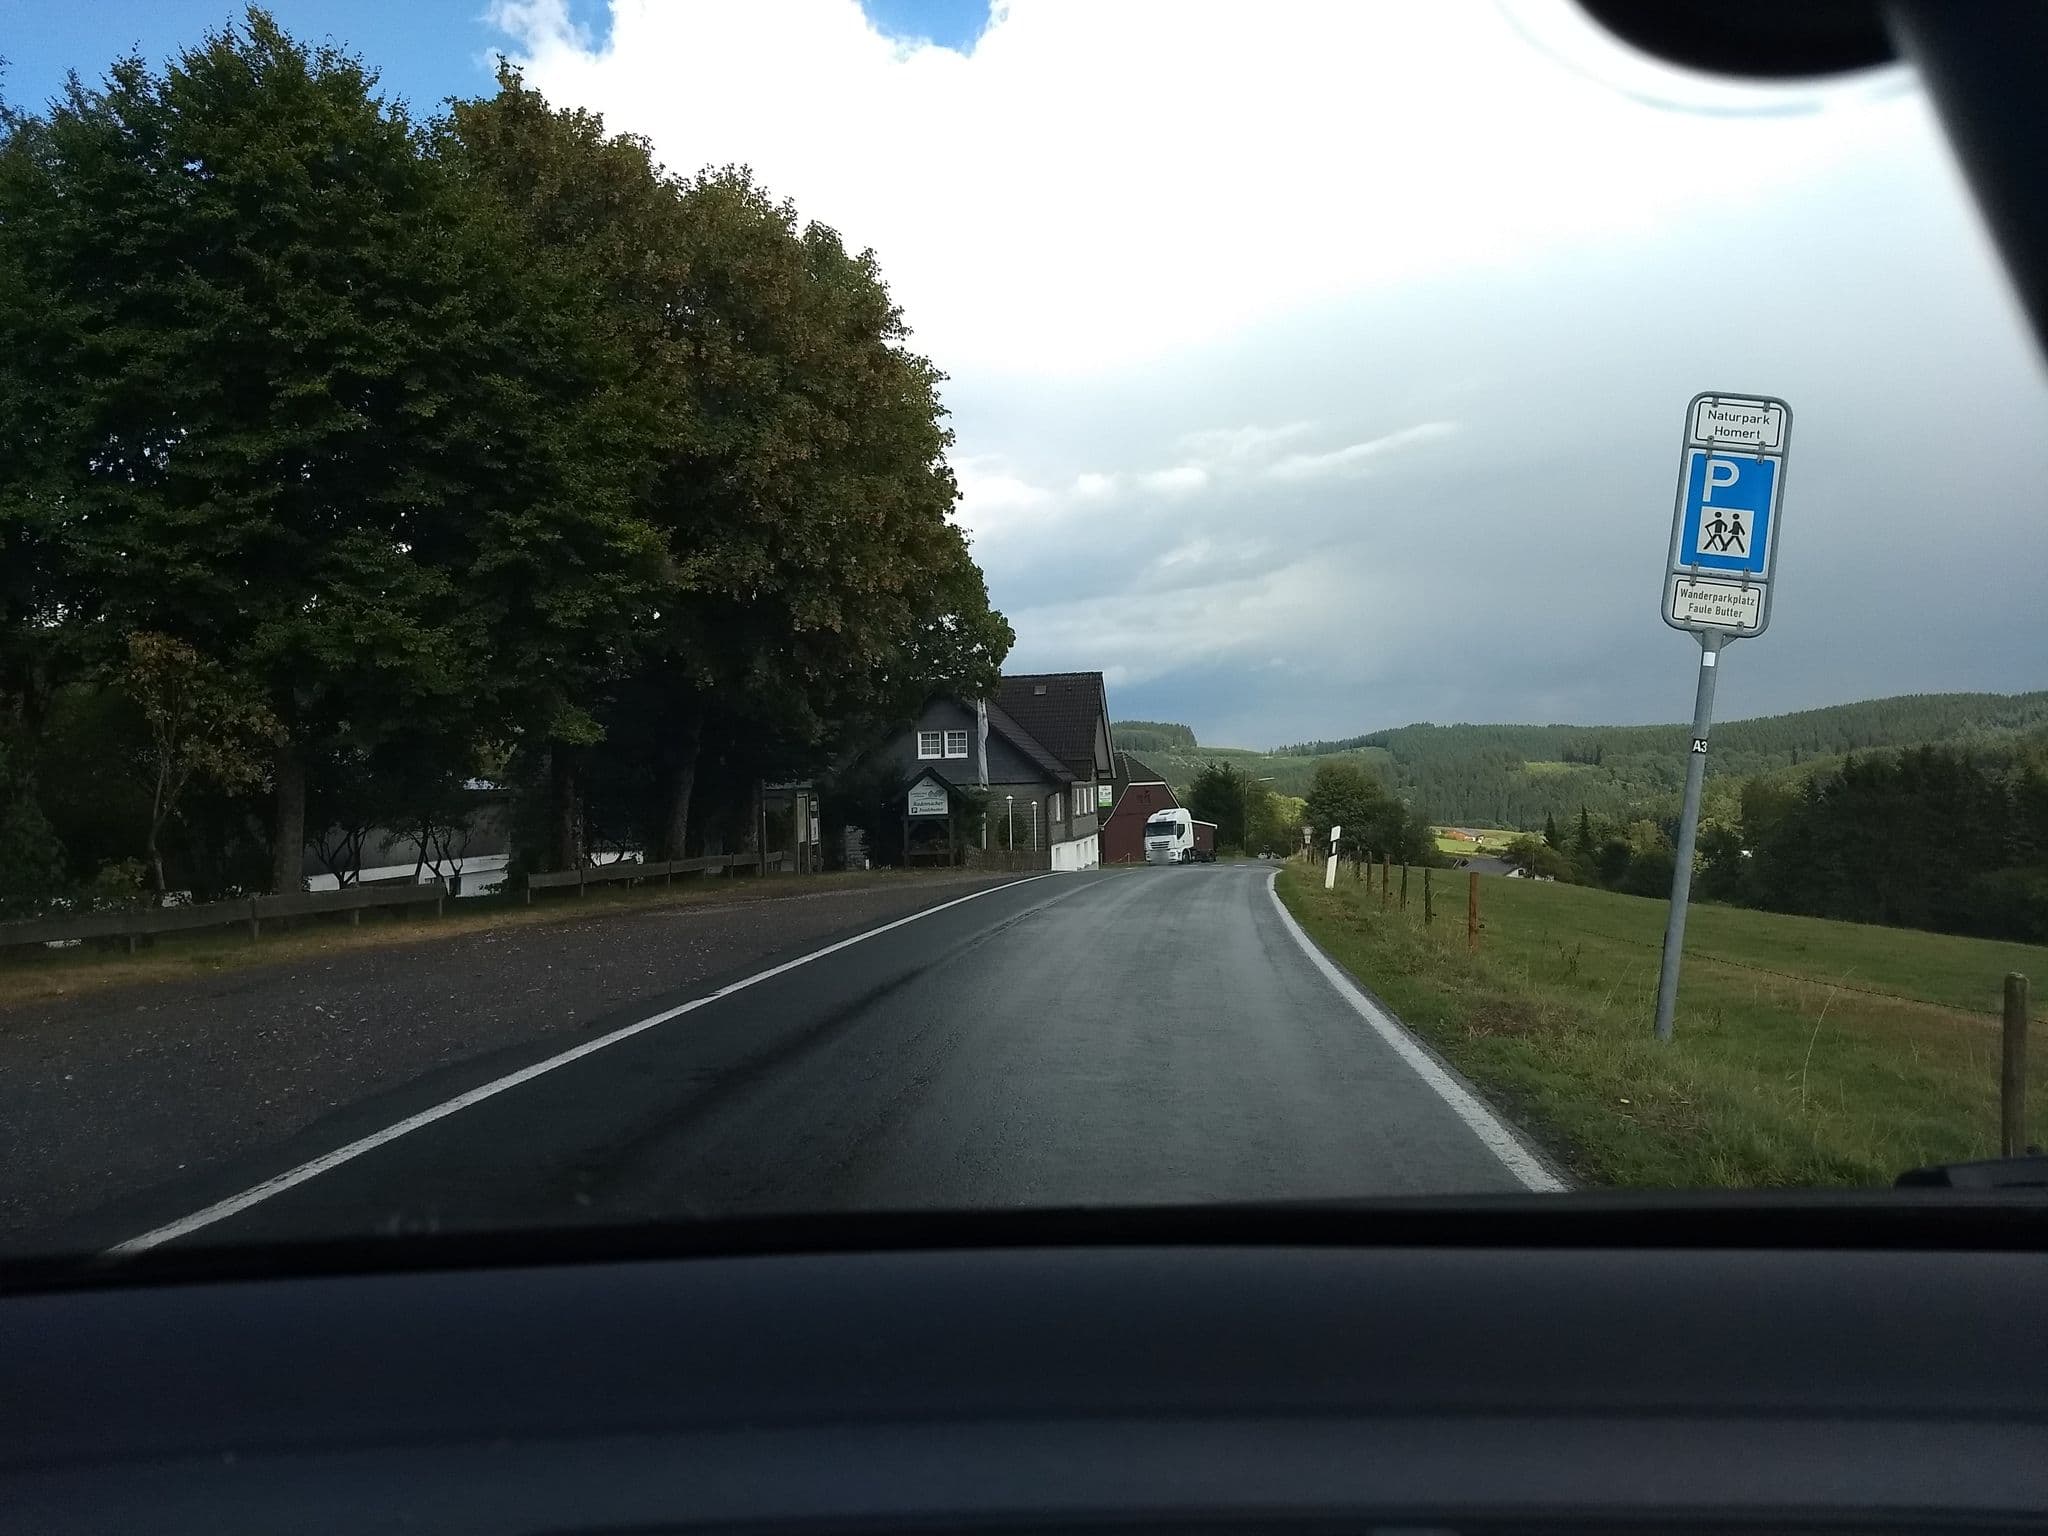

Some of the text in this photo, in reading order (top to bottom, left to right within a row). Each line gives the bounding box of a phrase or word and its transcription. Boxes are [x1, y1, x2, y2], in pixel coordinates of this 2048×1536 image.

[1707, 410, 1770, 425] Naturpark
[1714, 425, 1761, 440] Homert
[1702, 458, 1740, 502] P
[1680, 588, 1755, 606] Wanderparkplatz
[1688, 603, 1743, 618] Faule Butter
[1692, 740, 1708, 753] A3
